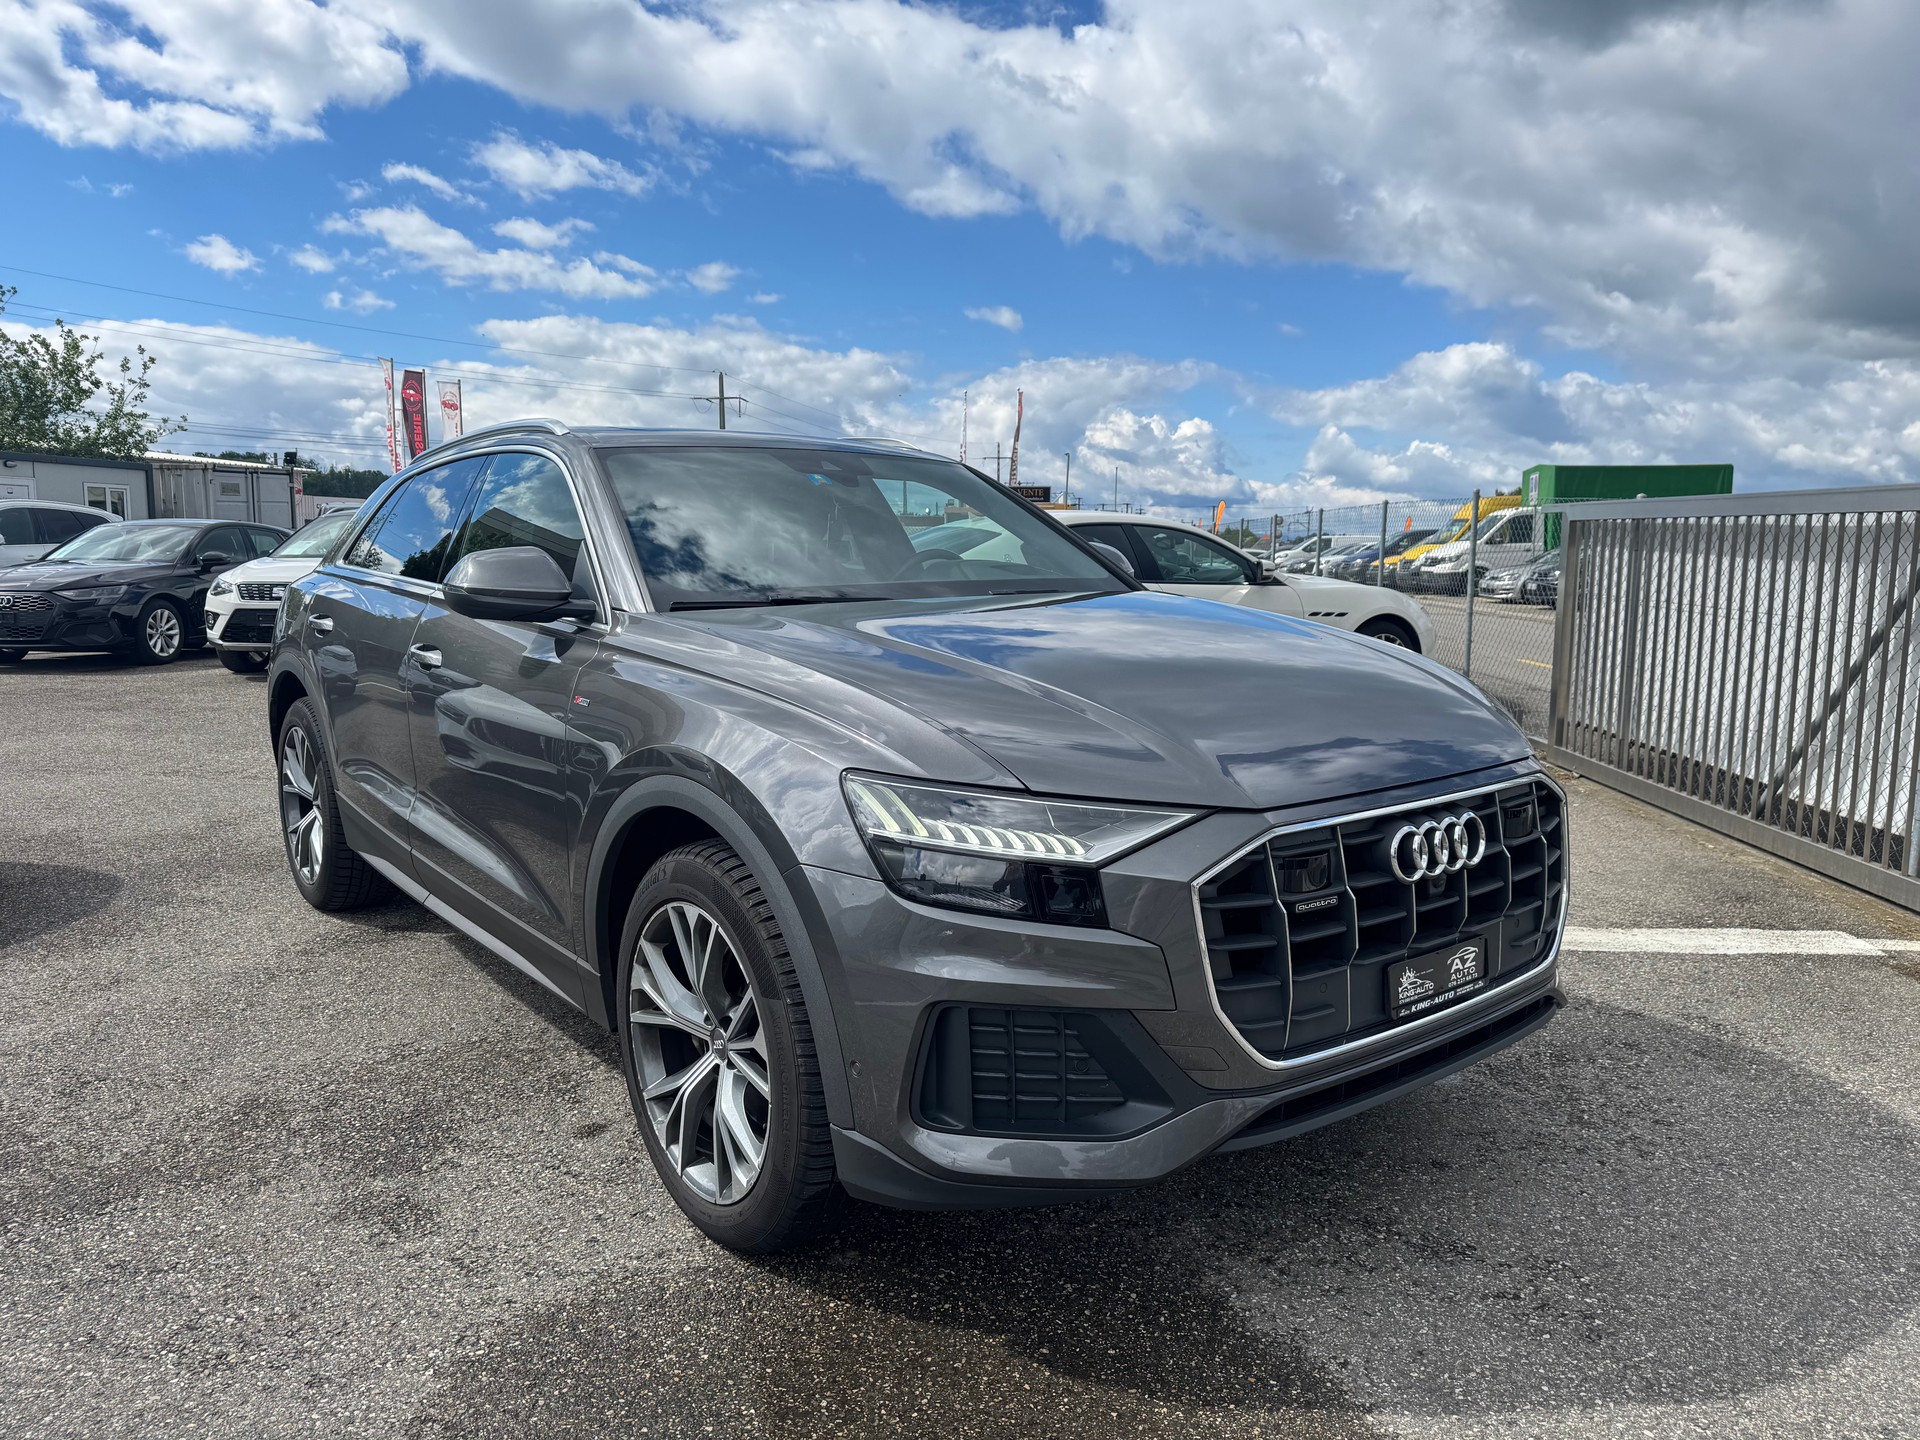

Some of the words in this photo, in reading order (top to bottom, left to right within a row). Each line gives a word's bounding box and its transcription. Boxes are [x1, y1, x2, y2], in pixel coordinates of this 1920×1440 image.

[1017, 488, 1044, 496] VENTE
[1298, 898, 1337, 911] quattro
[1450, 952, 1476, 973] AZ
[1450, 966, 1476, 981] AUTO
[1411, 990, 1454, 1013] KING-AUTO
